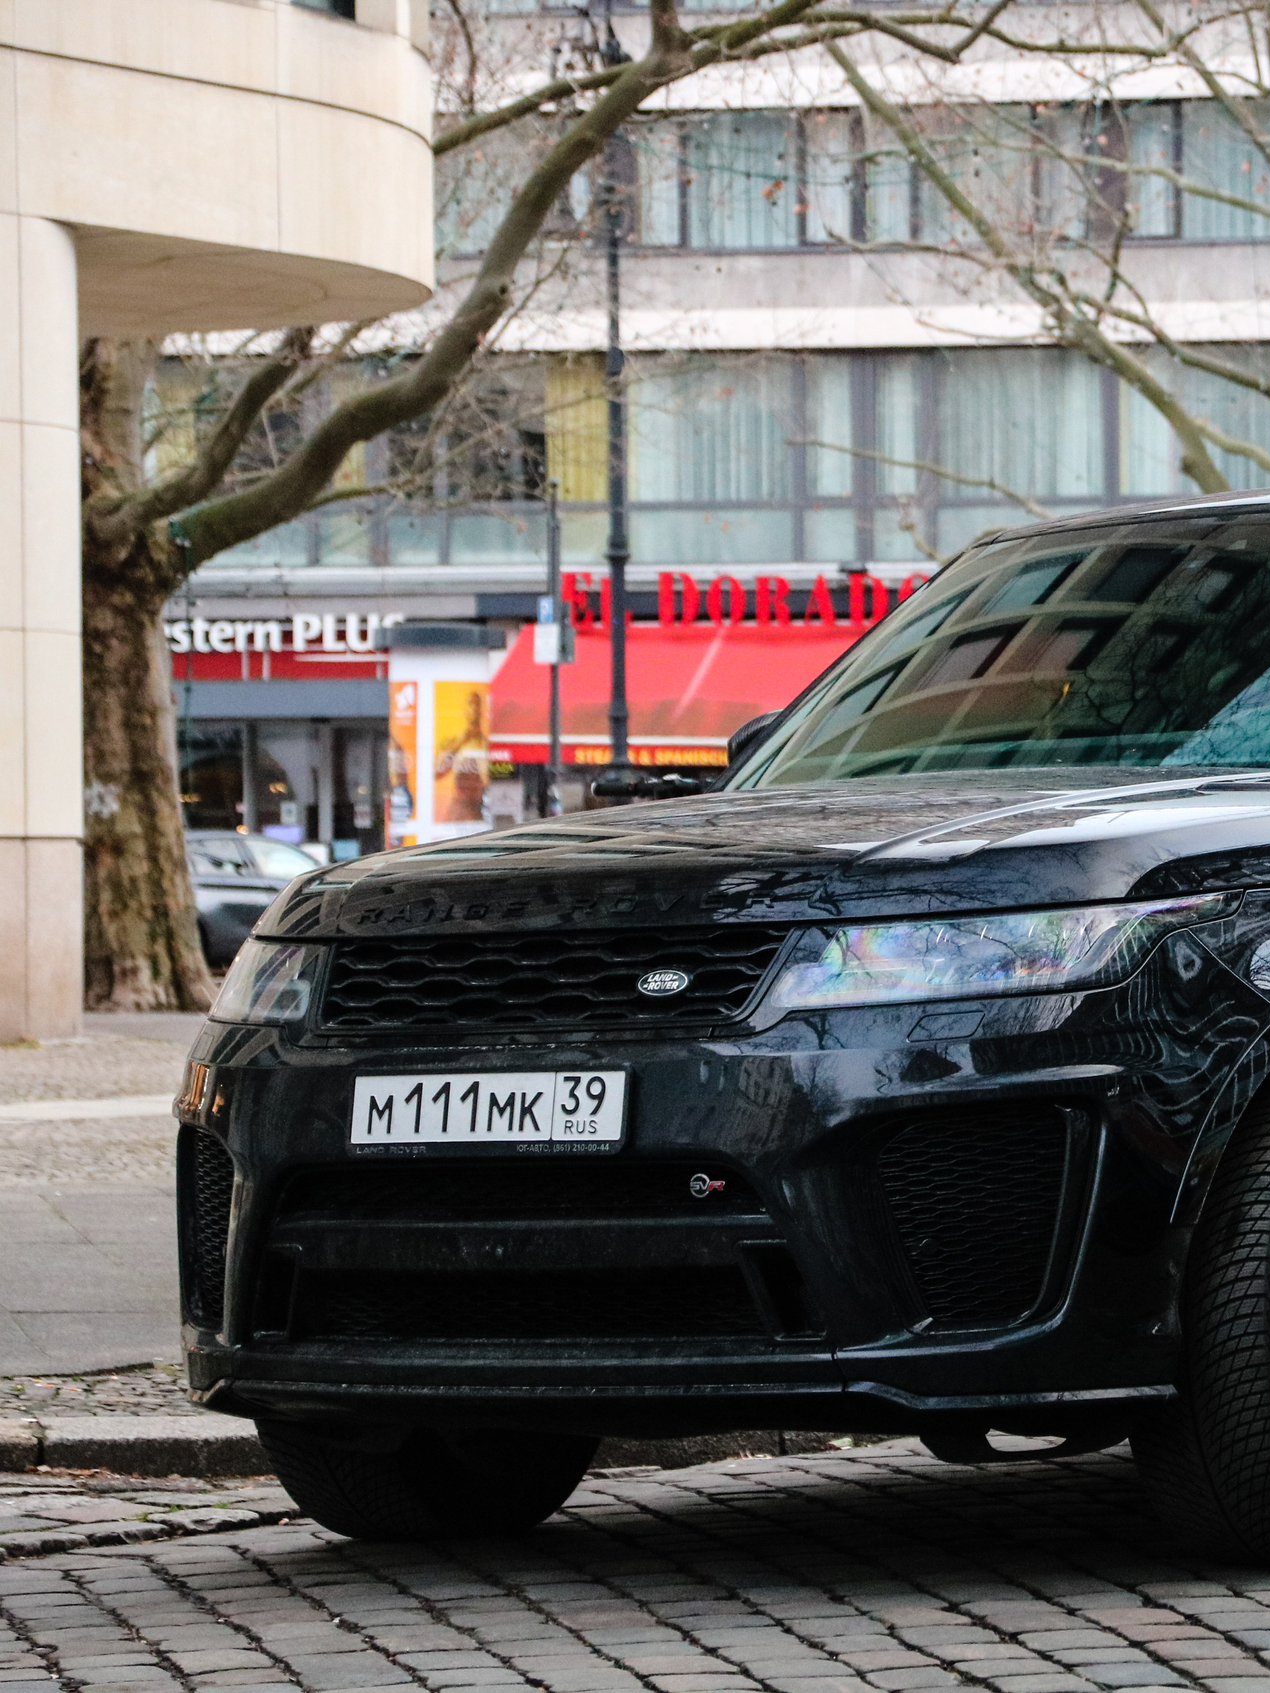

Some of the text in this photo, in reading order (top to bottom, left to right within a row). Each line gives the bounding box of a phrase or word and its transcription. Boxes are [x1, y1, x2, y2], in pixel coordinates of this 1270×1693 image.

[357, 891, 778, 926] RANGE ROVER
[647, 973, 674, 982] LAND
[647, 981, 679, 991] ROVER
[561, 1076, 607, 1116] 39
[564, 1120, 598, 1135] RUS
[356, 1145, 427, 1154] LAND ROVER
[572, 1142, 610, 1152] 210-00-44
[690, 1178, 725, 1193] SVR
